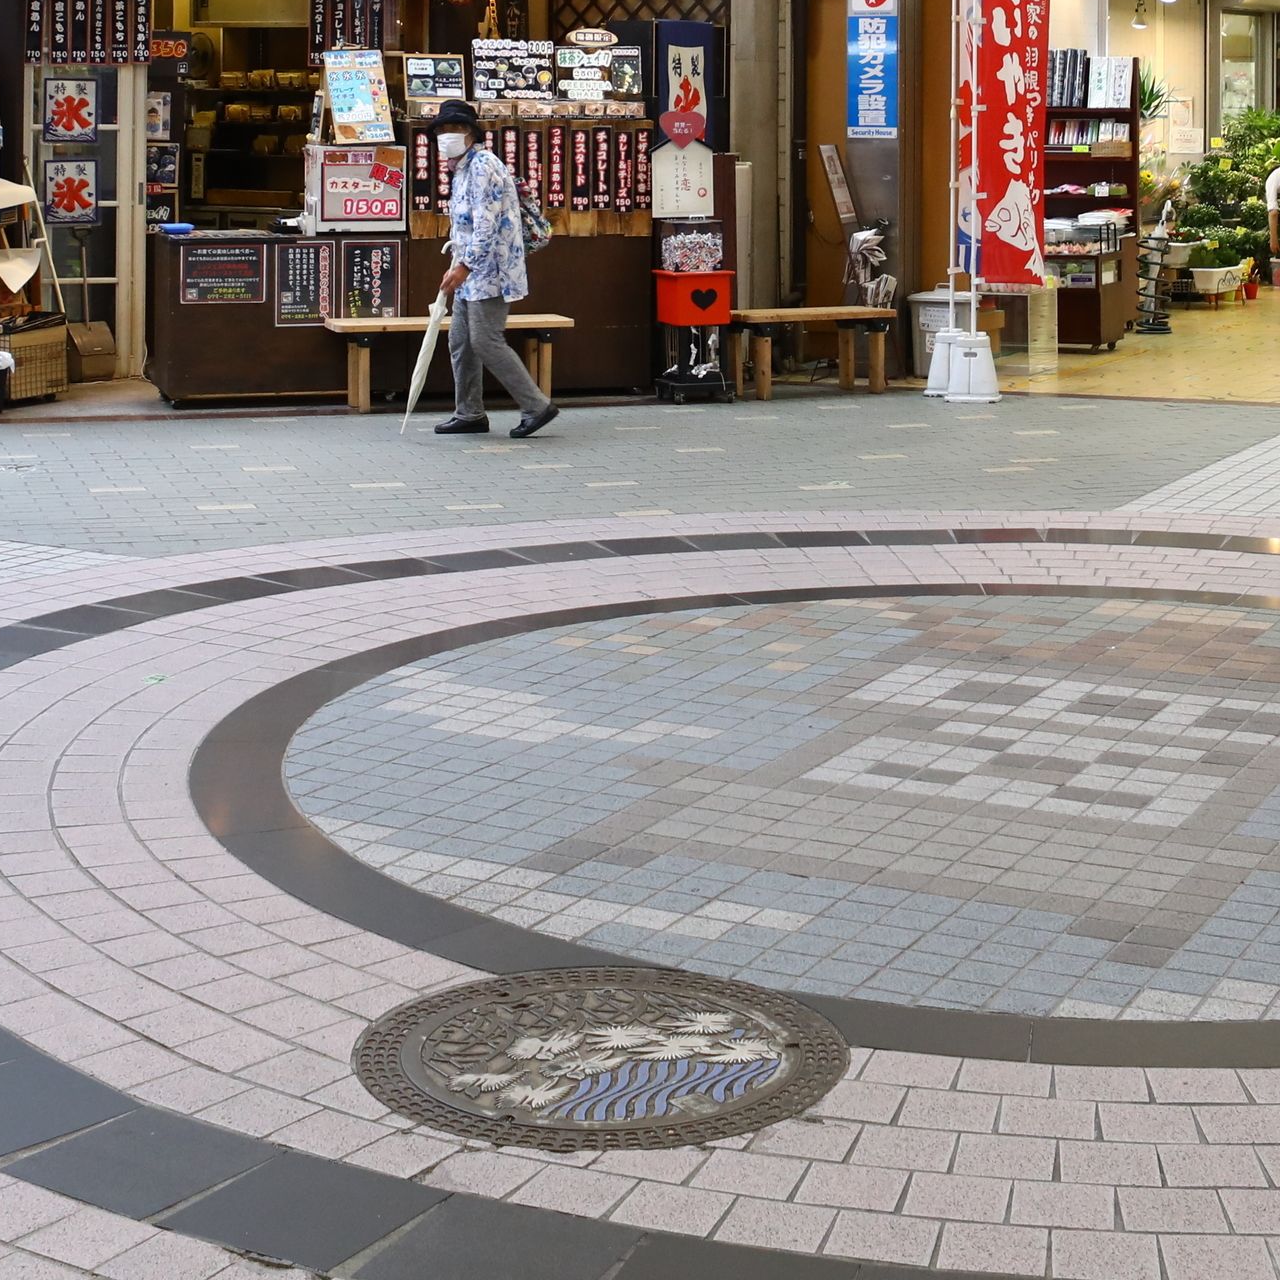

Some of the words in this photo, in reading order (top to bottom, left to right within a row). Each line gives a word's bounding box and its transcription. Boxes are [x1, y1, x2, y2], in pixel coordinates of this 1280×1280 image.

[857, 17, 887, 126] 防犯カメラ設置
[51, 95, 93, 132] 氷
[851, 129, 874, 137] Security
[875, 128, 893, 136] House
[416, 133, 428, 179] 小倉あん
[505, 130, 516, 179] 抹茶こも
[575, 132, 586, 187] カスタード
[596, 132, 607, 193] チョコレート
[51, 176, 93, 213] 氷
[328, 178, 383, 194] カスタード
[370, 163, 404, 189] 限定
[344, 199, 400, 216] 150円
